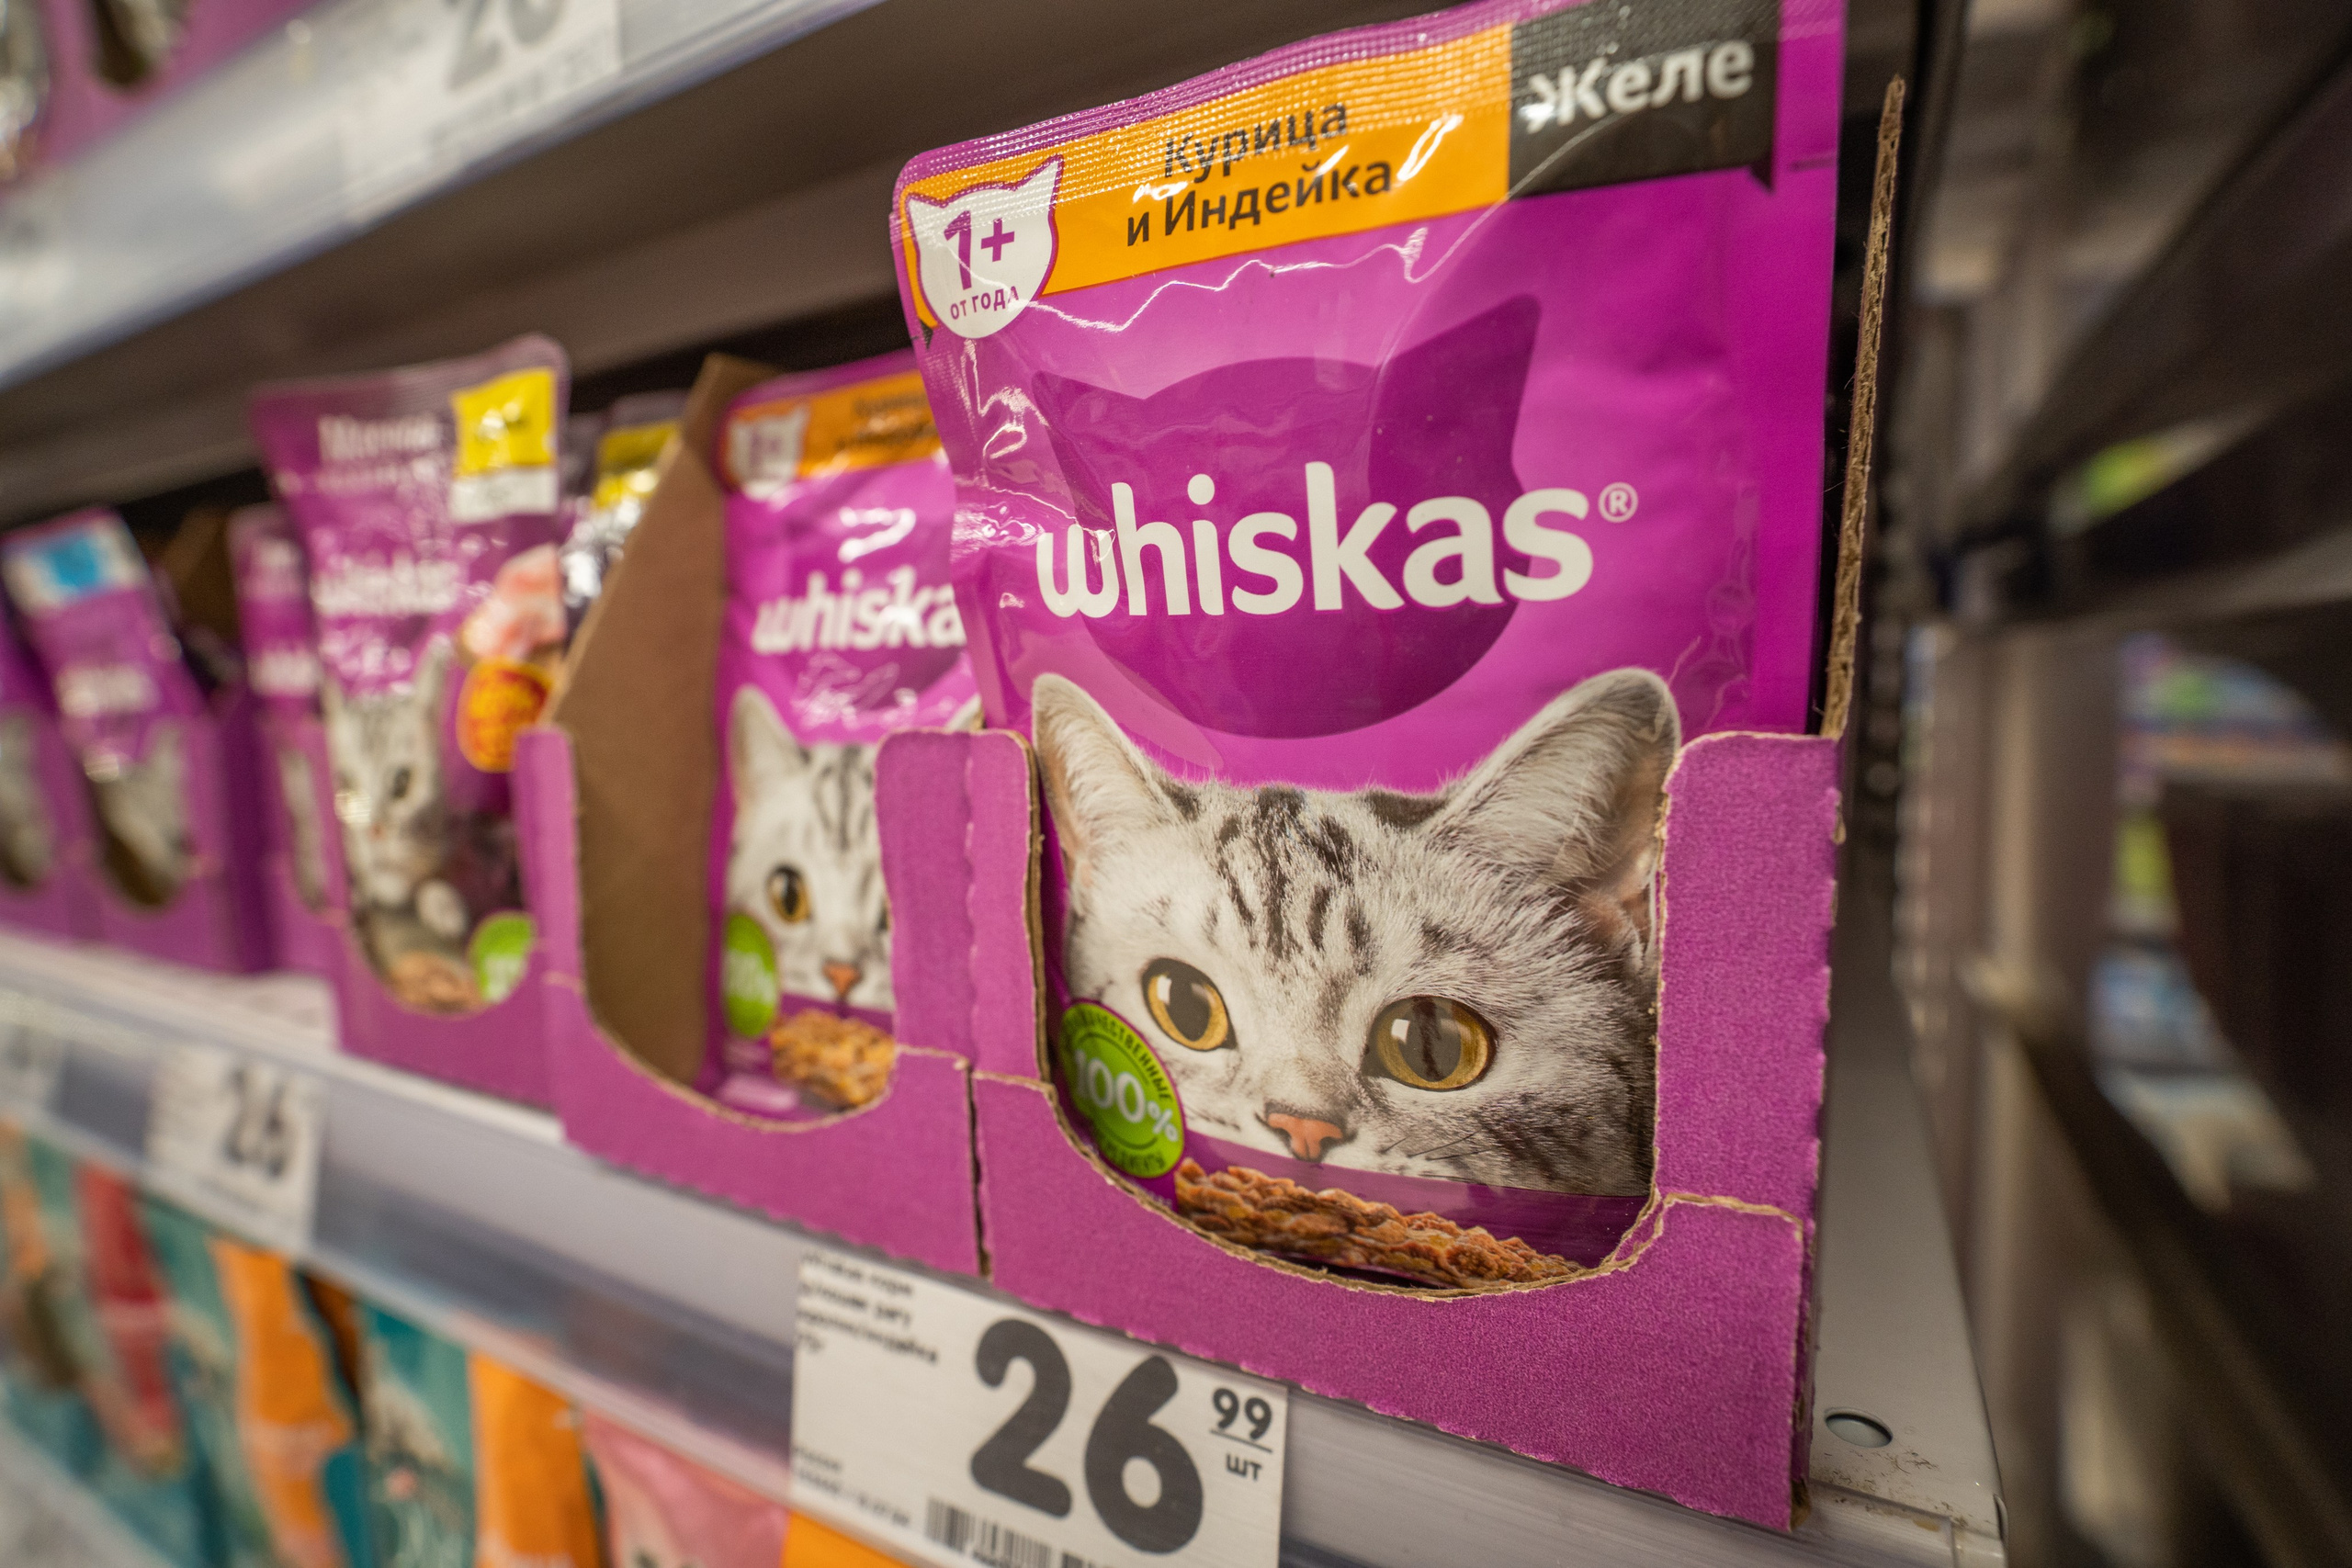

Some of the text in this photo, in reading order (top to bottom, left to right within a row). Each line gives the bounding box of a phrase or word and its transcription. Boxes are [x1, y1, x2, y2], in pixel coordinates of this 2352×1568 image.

[1520, 39, 1755, 134] Желе
[1163, 101, 1347, 184] Курица
[1126, 159, 1392, 247] и Индейка
[944, 209, 1015, 290] 1+
[949, 298, 968, 321] ОТ
[1073, 1048, 1180, 1143] 100%
[970, 1318, 1204, 1554] 26
[1212, 1388, 1273, 1441] 99
[1225, 1452, 1264, 1482] шт
